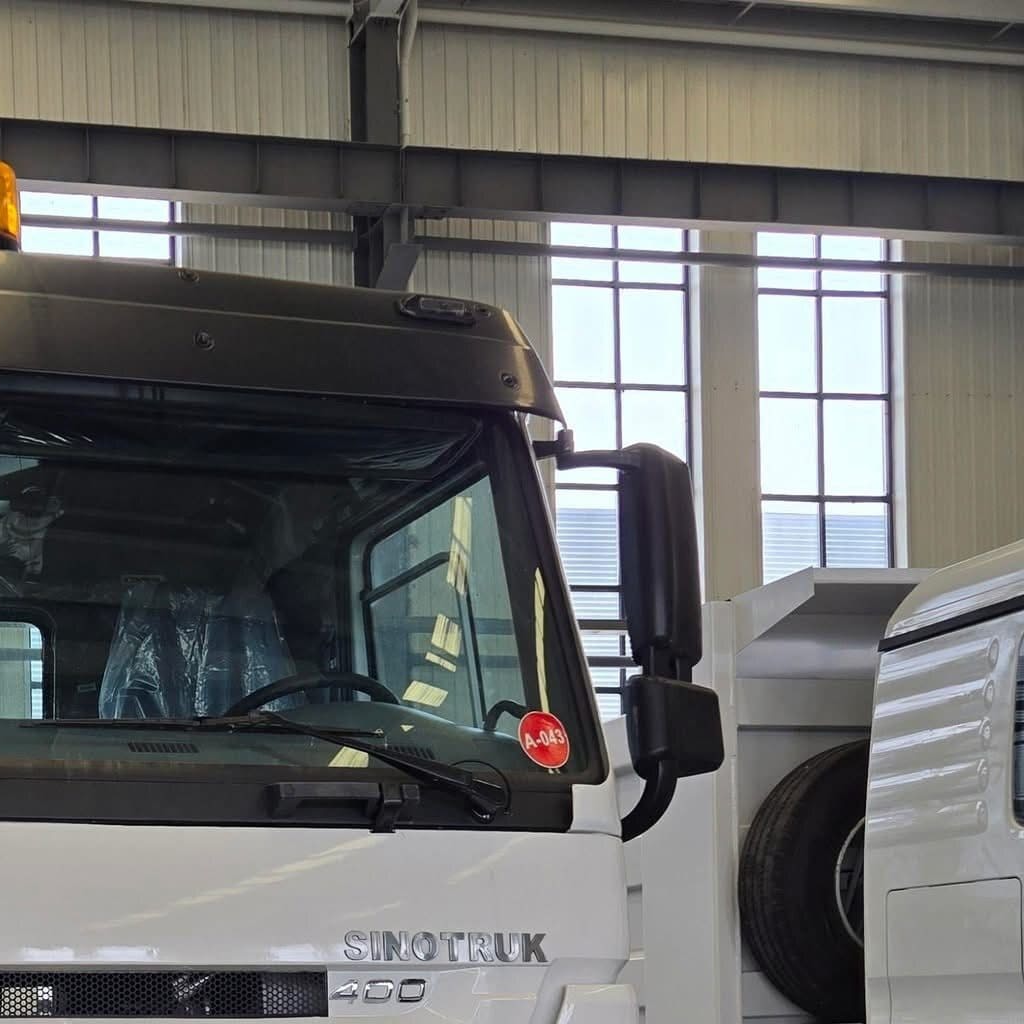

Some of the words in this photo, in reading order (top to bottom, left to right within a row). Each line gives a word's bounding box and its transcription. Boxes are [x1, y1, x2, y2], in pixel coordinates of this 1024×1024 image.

[524, 728, 565, 749] A-043
[344, 930, 548, 963] SINOTRUK
[331, 979, 426, 1003] 400
